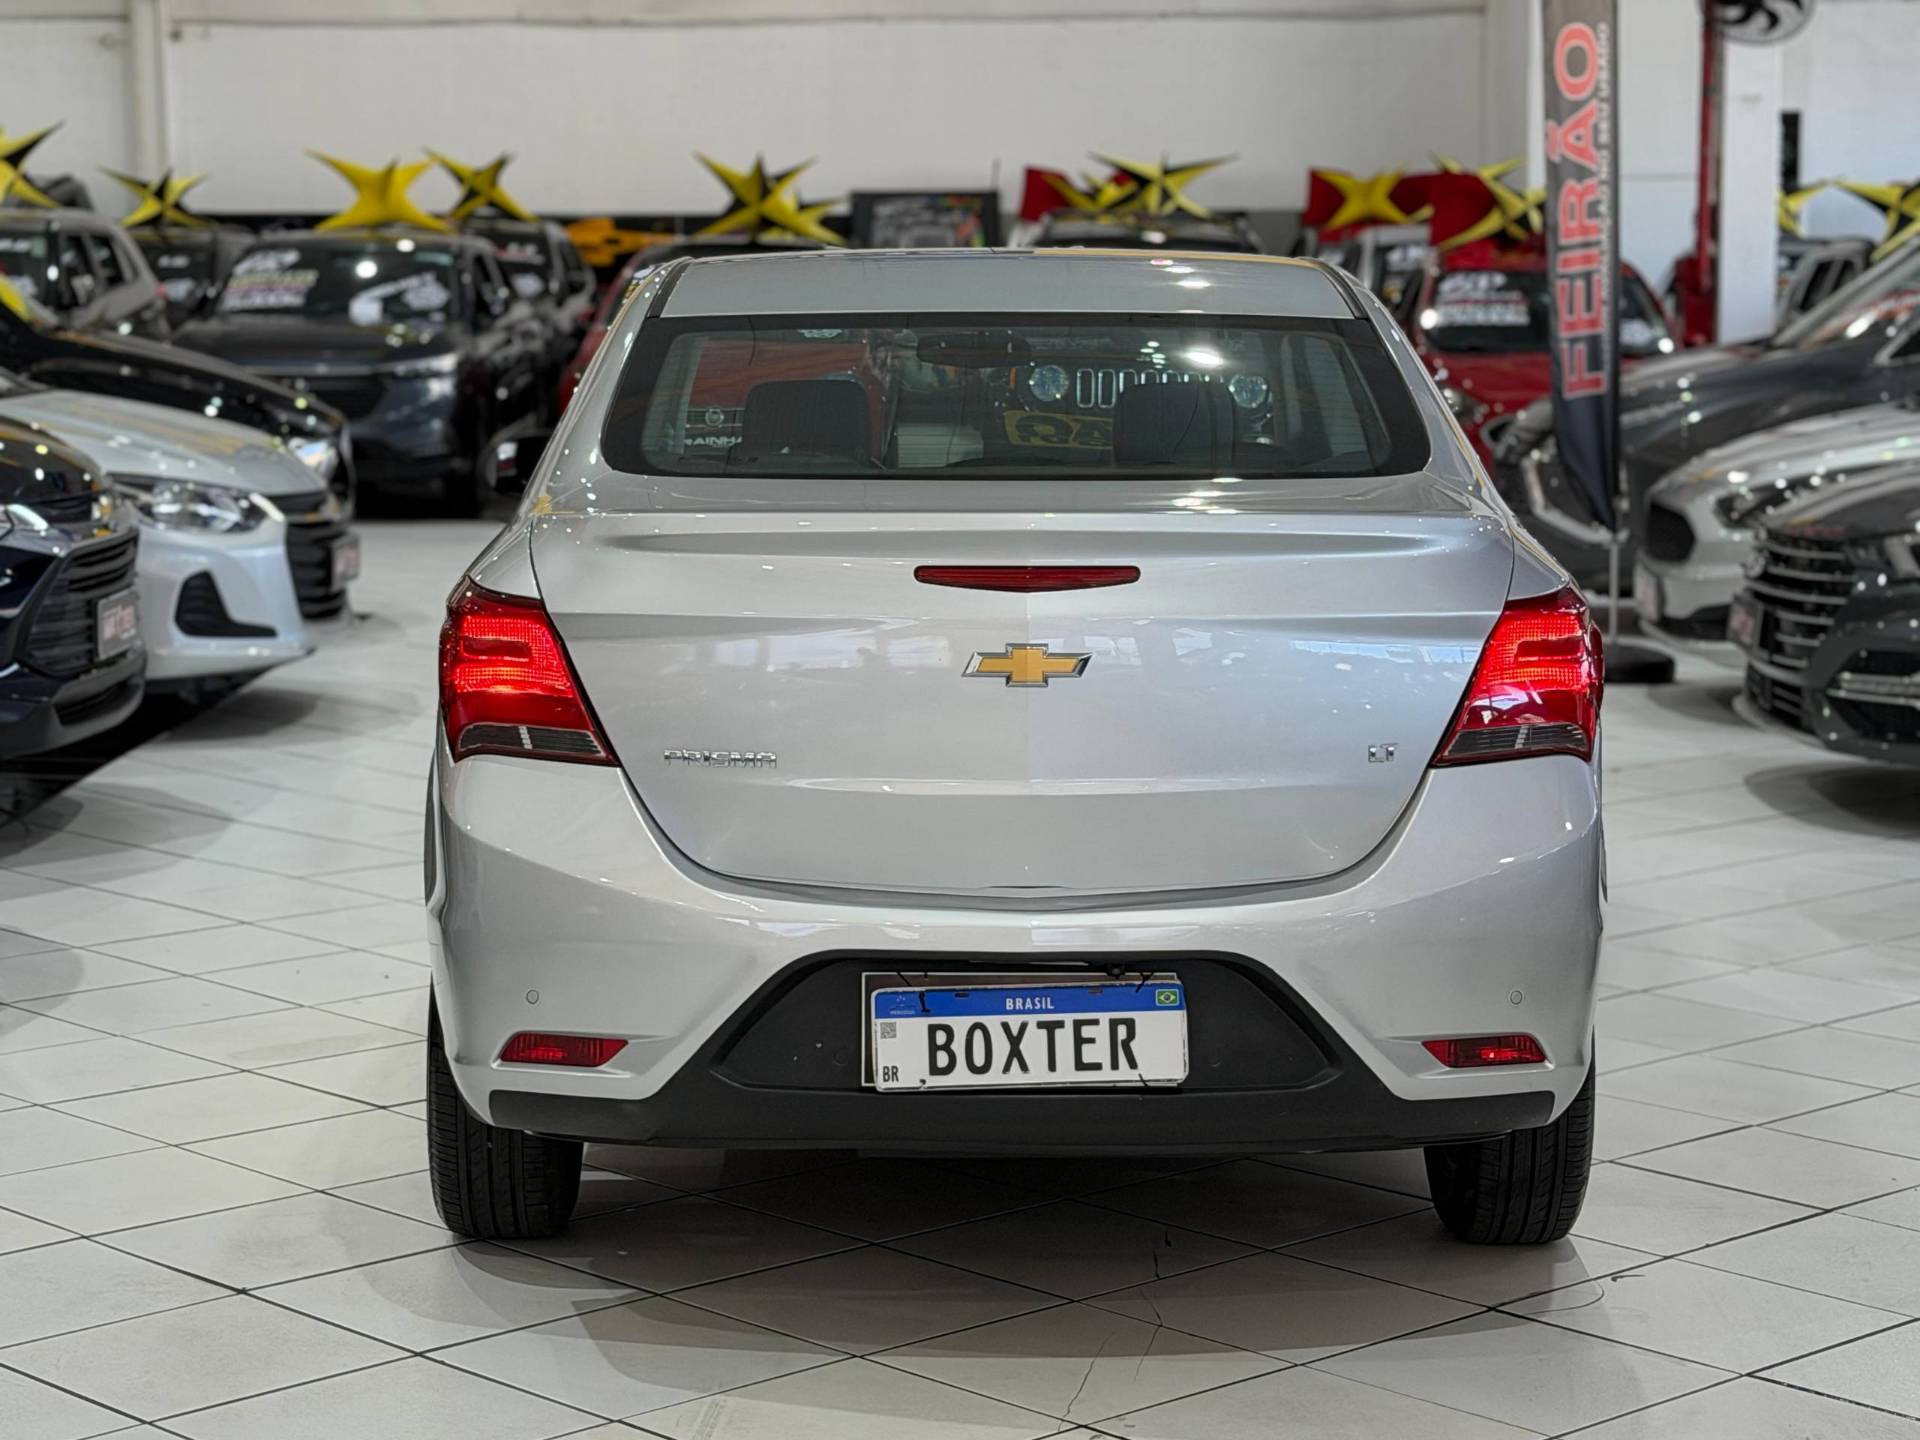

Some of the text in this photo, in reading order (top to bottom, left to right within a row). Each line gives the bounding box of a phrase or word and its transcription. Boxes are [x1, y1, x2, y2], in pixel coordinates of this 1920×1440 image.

[1546, 22, 1607, 399] FEIRÃO
[664, 750, 777, 768] PRISMA
[1005, 997, 1055, 1011] BRASIL
[927, 1017, 1138, 1076] BOXTER
[882, 1065, 900, 1083] BR
